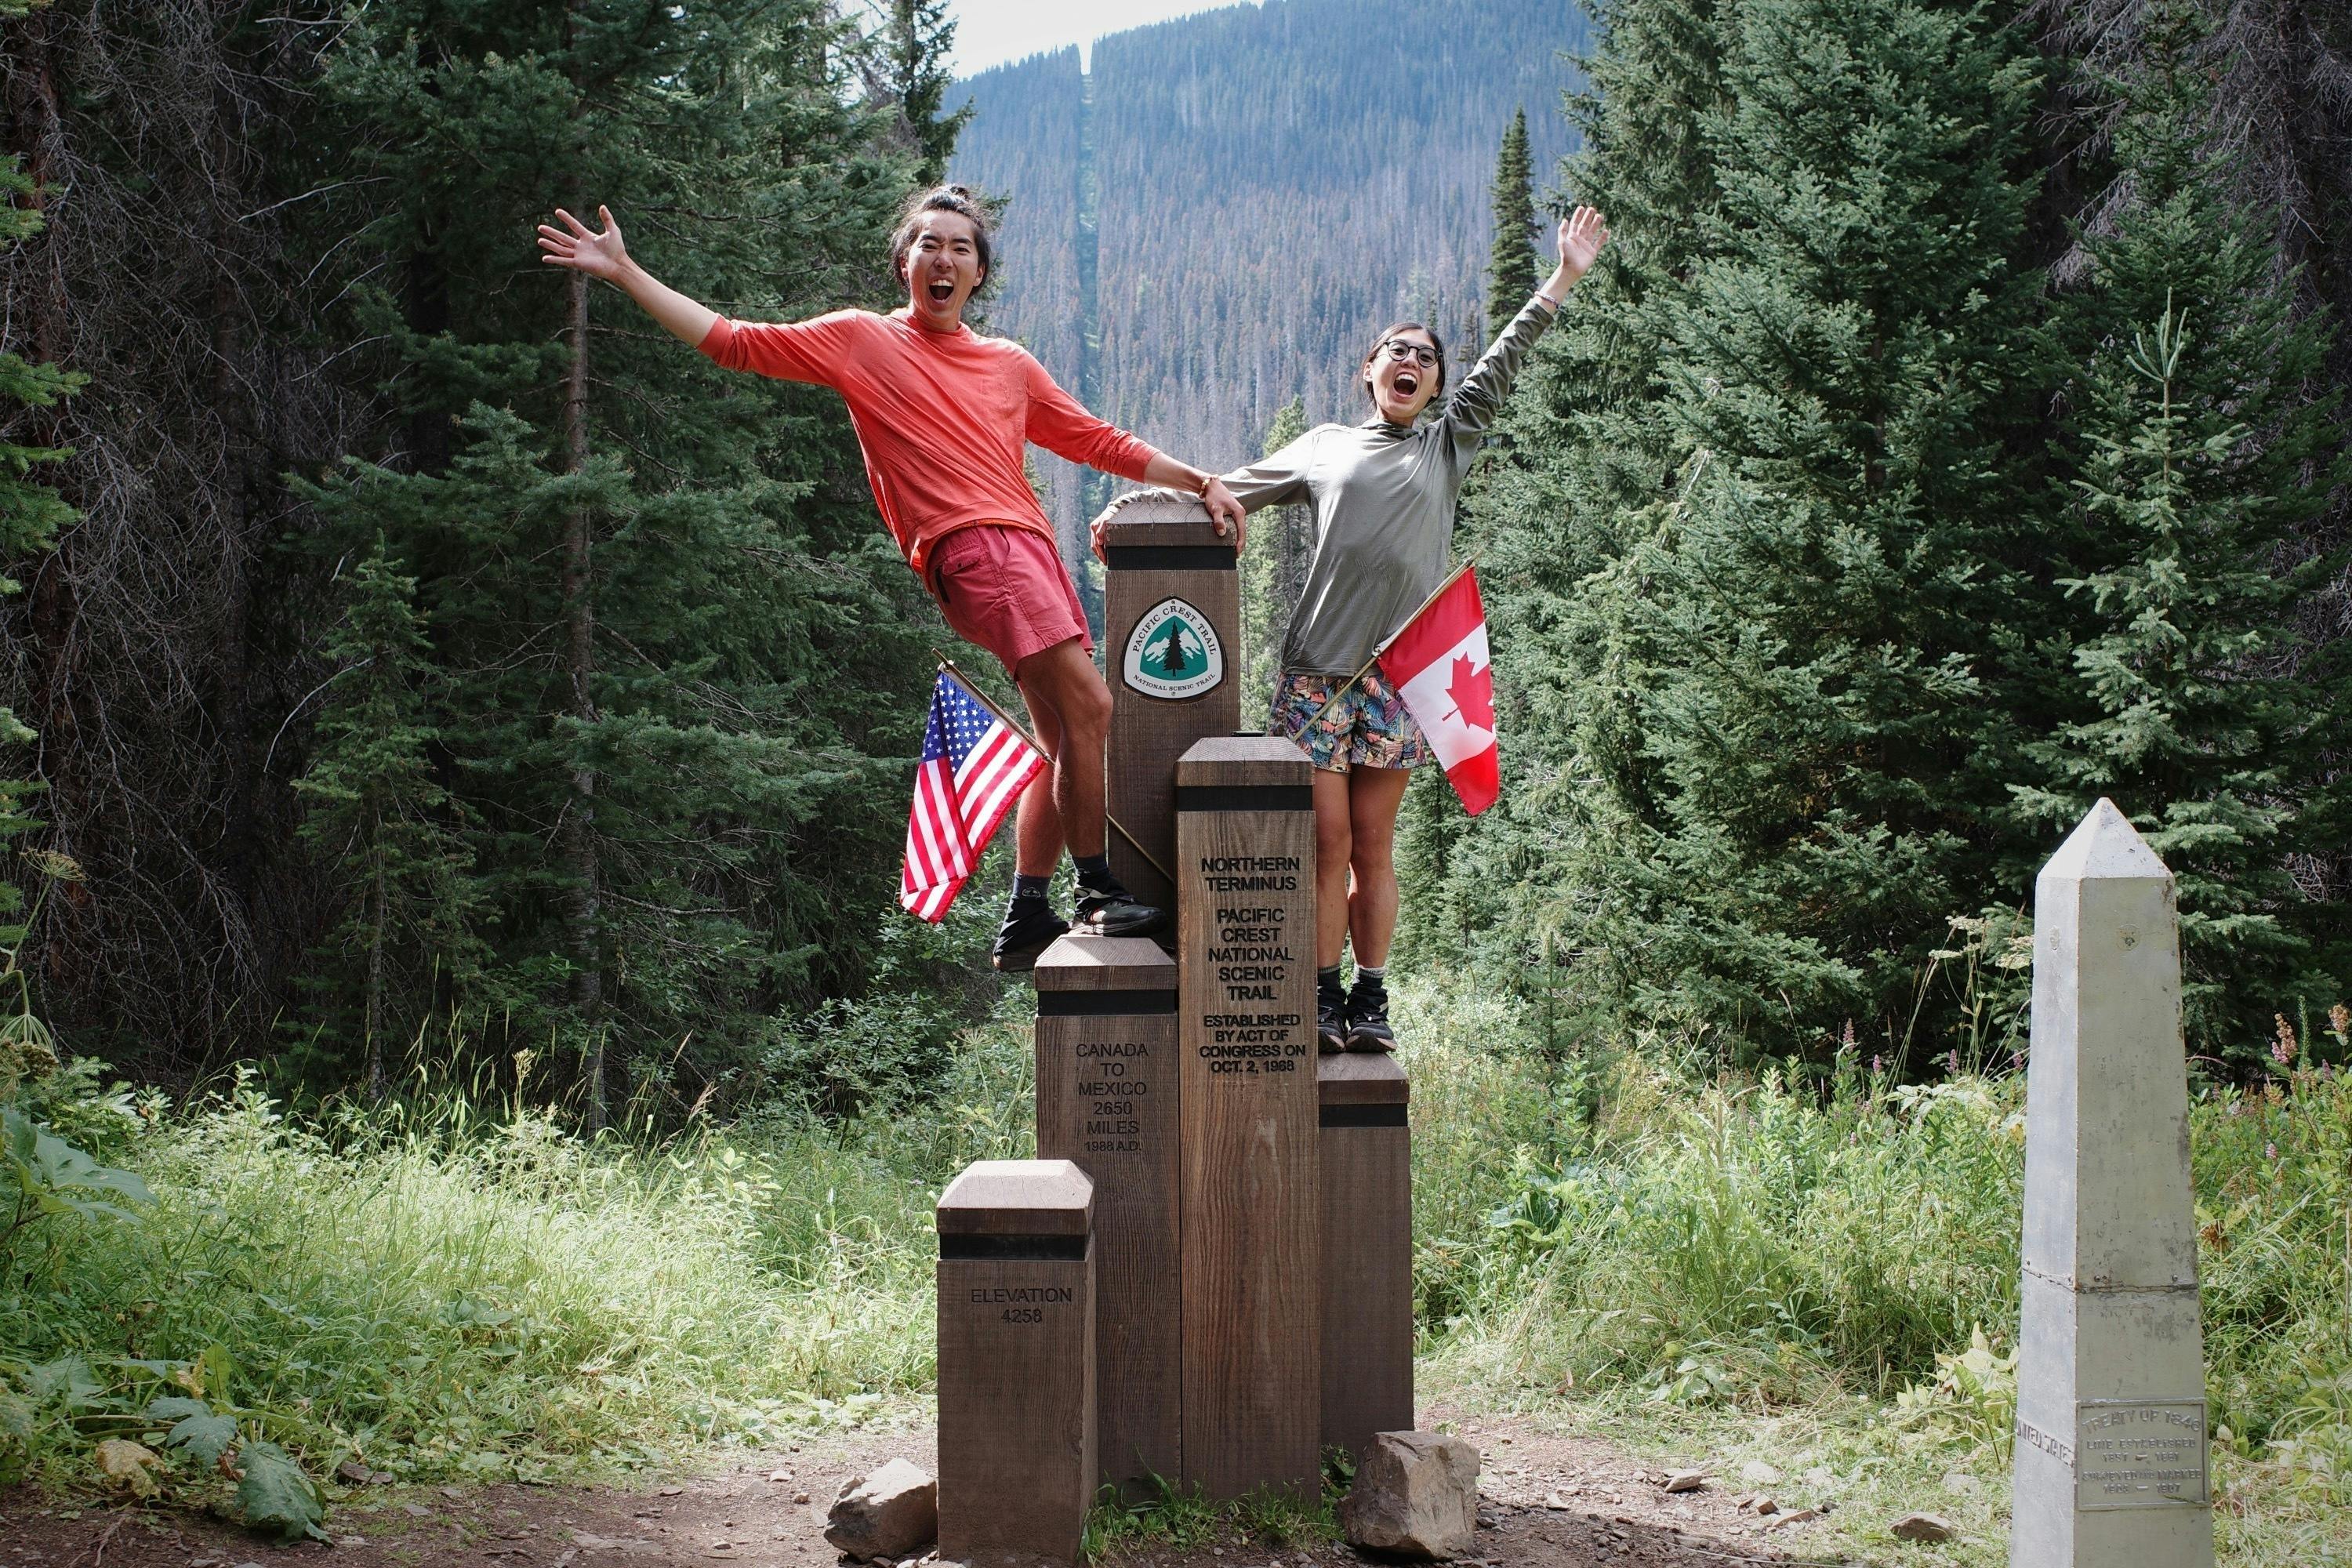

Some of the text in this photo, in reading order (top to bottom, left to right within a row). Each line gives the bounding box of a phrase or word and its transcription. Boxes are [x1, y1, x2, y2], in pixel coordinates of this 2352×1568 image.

[1133, 605, 1217, 655] PACIFIC CREST TRAIL
[1133, 674, 1167, 691] NATIONAL
[1196, 673, 1216, 687] TRAIL
[1201, 857, 1300, 872] NORTHERN
[1205, 876, 1297, 892] TERMINUS
[1217, 908, 1285, 924] PACIFIC
[1221, 927, 1281, 942] CREST
[1208, 947, 1294, 962] NATIONAL
[1218, 966, 1285, 981] SCENIC
[1227, 985, 1277, 1001] TRAIL
[1203, 1014, 1301, 1027] ESTABLISHED
[1215, 1029, 1289, 1043] BY ACT OF
[1076, 1043, 1149, 1058] CANADA
[1200, 1044, 1306, 1058] CONGRESS ON
[1100, 1062, 1124, 1076] TO
[1210, 1060, 1294, 1074] OCT. 2, 1968
[1078, 1082, 1147, 1096] MEXICO
[1093, 1102, 1133, 1115] 2650
[1087, 1120, 1139, 1134] MILES
[1084, 1141, 1114, 1152] 1988
[971, 1288, 1072, 1303] ELEVATION
[1001, 1309, 1042, 1323] 4258
[2082, 1409, 2201, 1434] TREATY OF 1846
[2087, 1438, 2113, 1450] LINE
